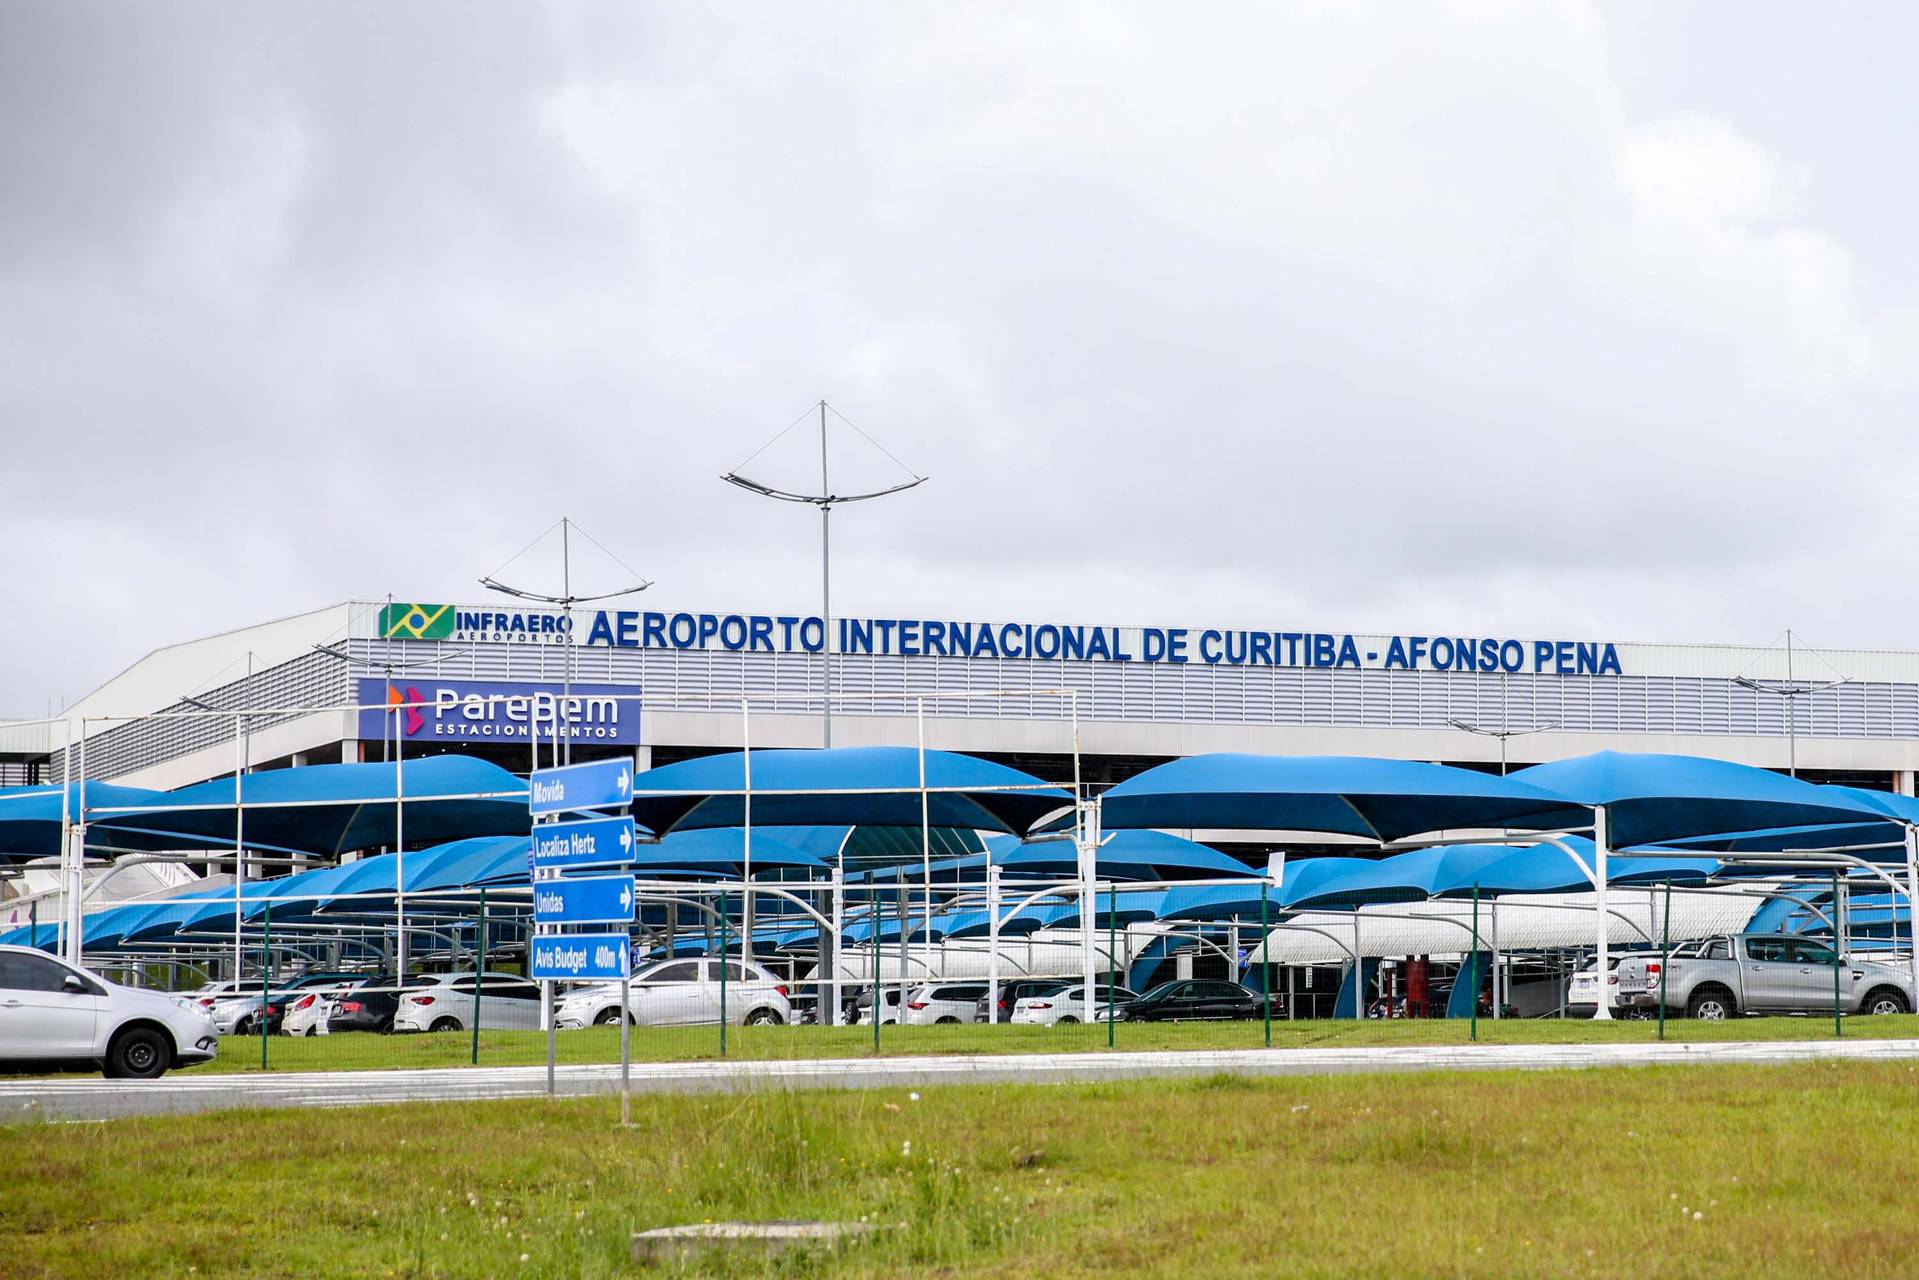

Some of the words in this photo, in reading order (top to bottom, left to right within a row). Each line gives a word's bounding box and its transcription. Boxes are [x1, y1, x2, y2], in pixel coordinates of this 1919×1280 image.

[456, 612, 573, 634] INFRAERO
[457, 632, 573, 645] AEROPORTOS
[587, 611, 826, 653] AEROPORTO
[839, 618, 1132, 661] INTERNACIONAL
[1142, 628, 1189, 663] DE
[1199, 630, 1361, 669] CURITIBA
[1384, 636, 1525, 675] AFONSO
[1534, 640, 1622, 675] PENA
[435, 688, 618, 724] PareBem
[533, 779, 565, 803] Movida
[535, 834, 570, 859] Localiza
[571, 832, 596, 855] Hertz
[536, 891, 564, 914] Unidas
[535, 946, 554, 969] Avis
[555, 945, 587, 975] Budget
[595, 944, 616, 969] 400m
